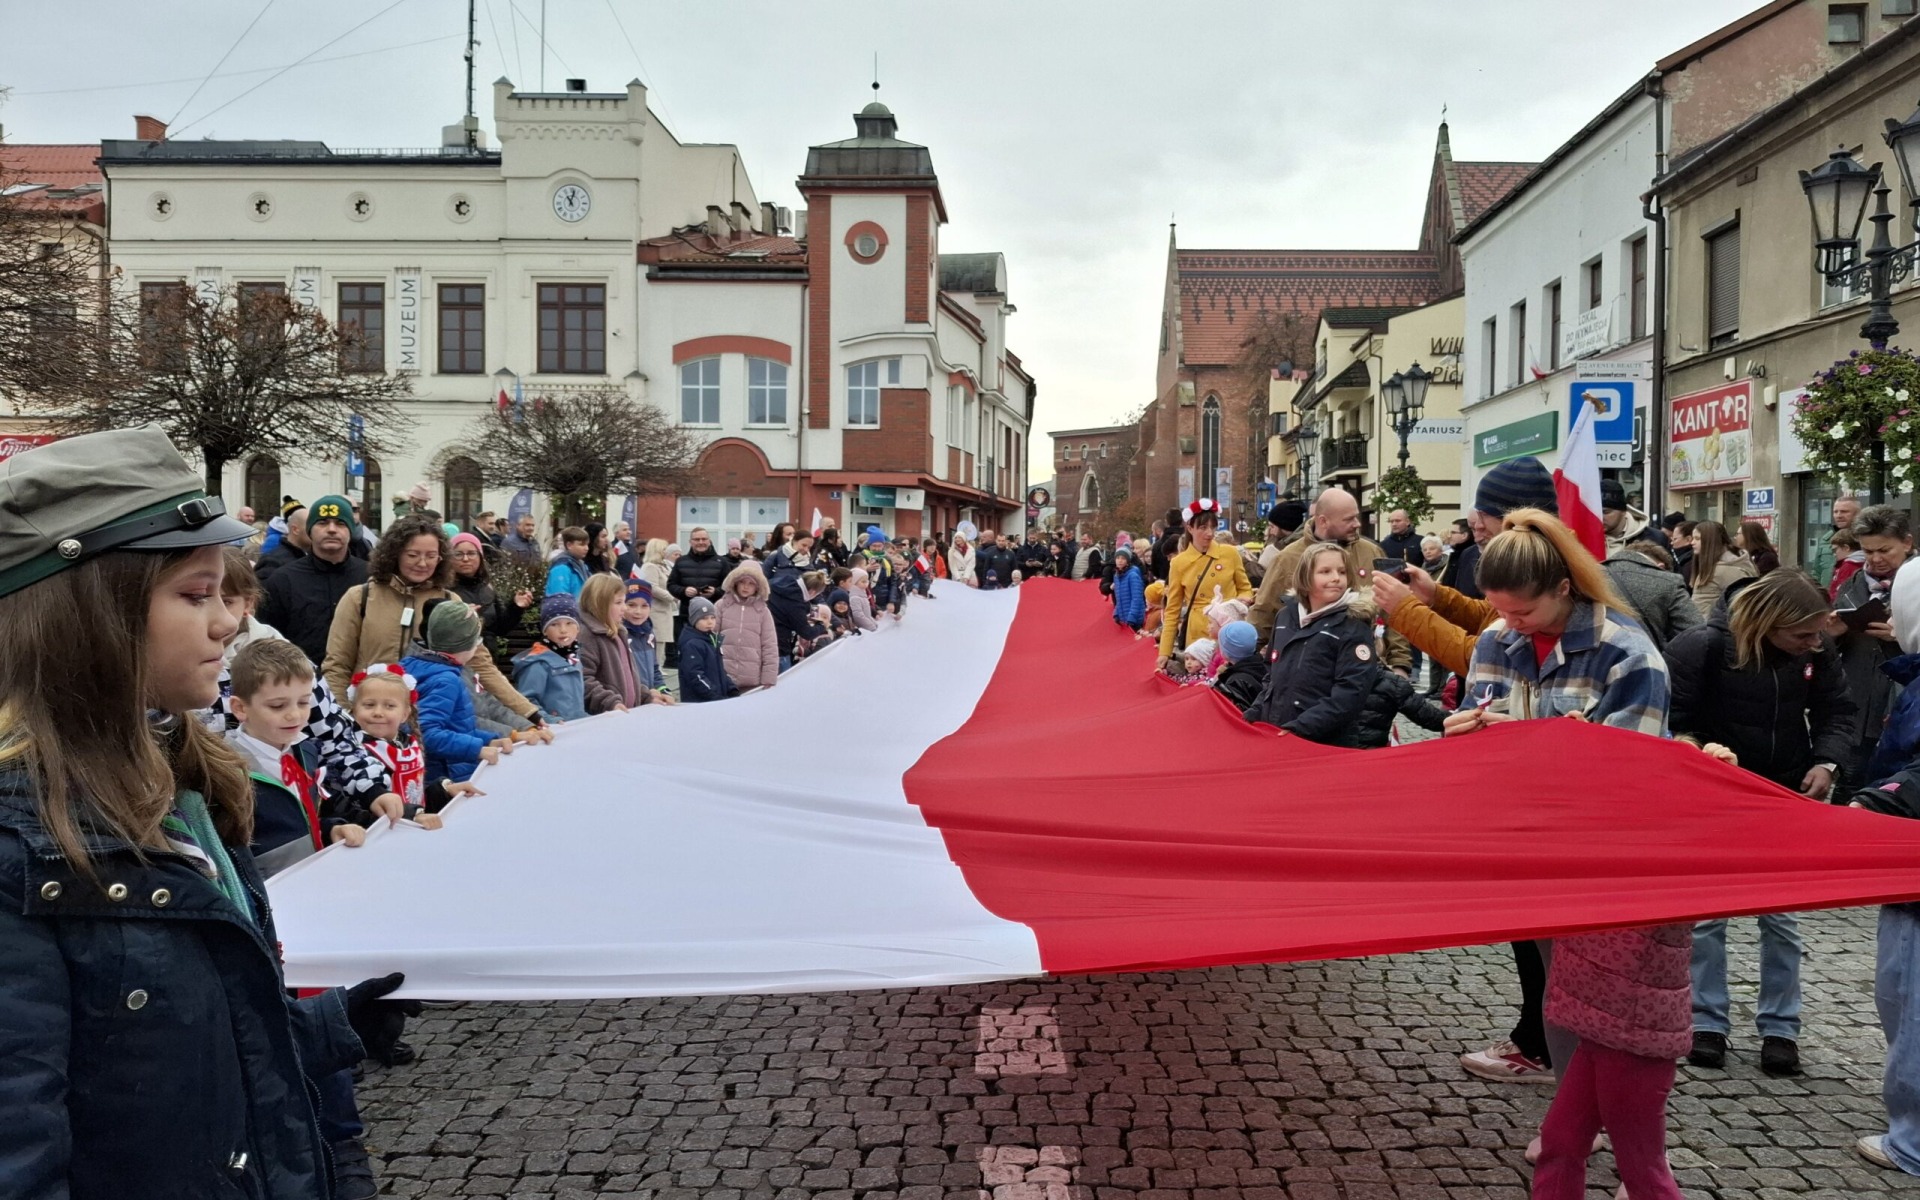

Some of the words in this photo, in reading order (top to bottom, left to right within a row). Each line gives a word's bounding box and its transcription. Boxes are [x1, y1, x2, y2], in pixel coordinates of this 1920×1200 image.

[401, 279, 416, 364] MUZEUM
[1578, 309, 1598, 326] LOKAL
[1430, 336, 1464, 354] Will
[1584, 388, 1621, 421] P
[1673, 394, 1747, 436] KANTOR
[1596, 449, 1626, 462] niec
[1752, 490, 1768, 504] 20
